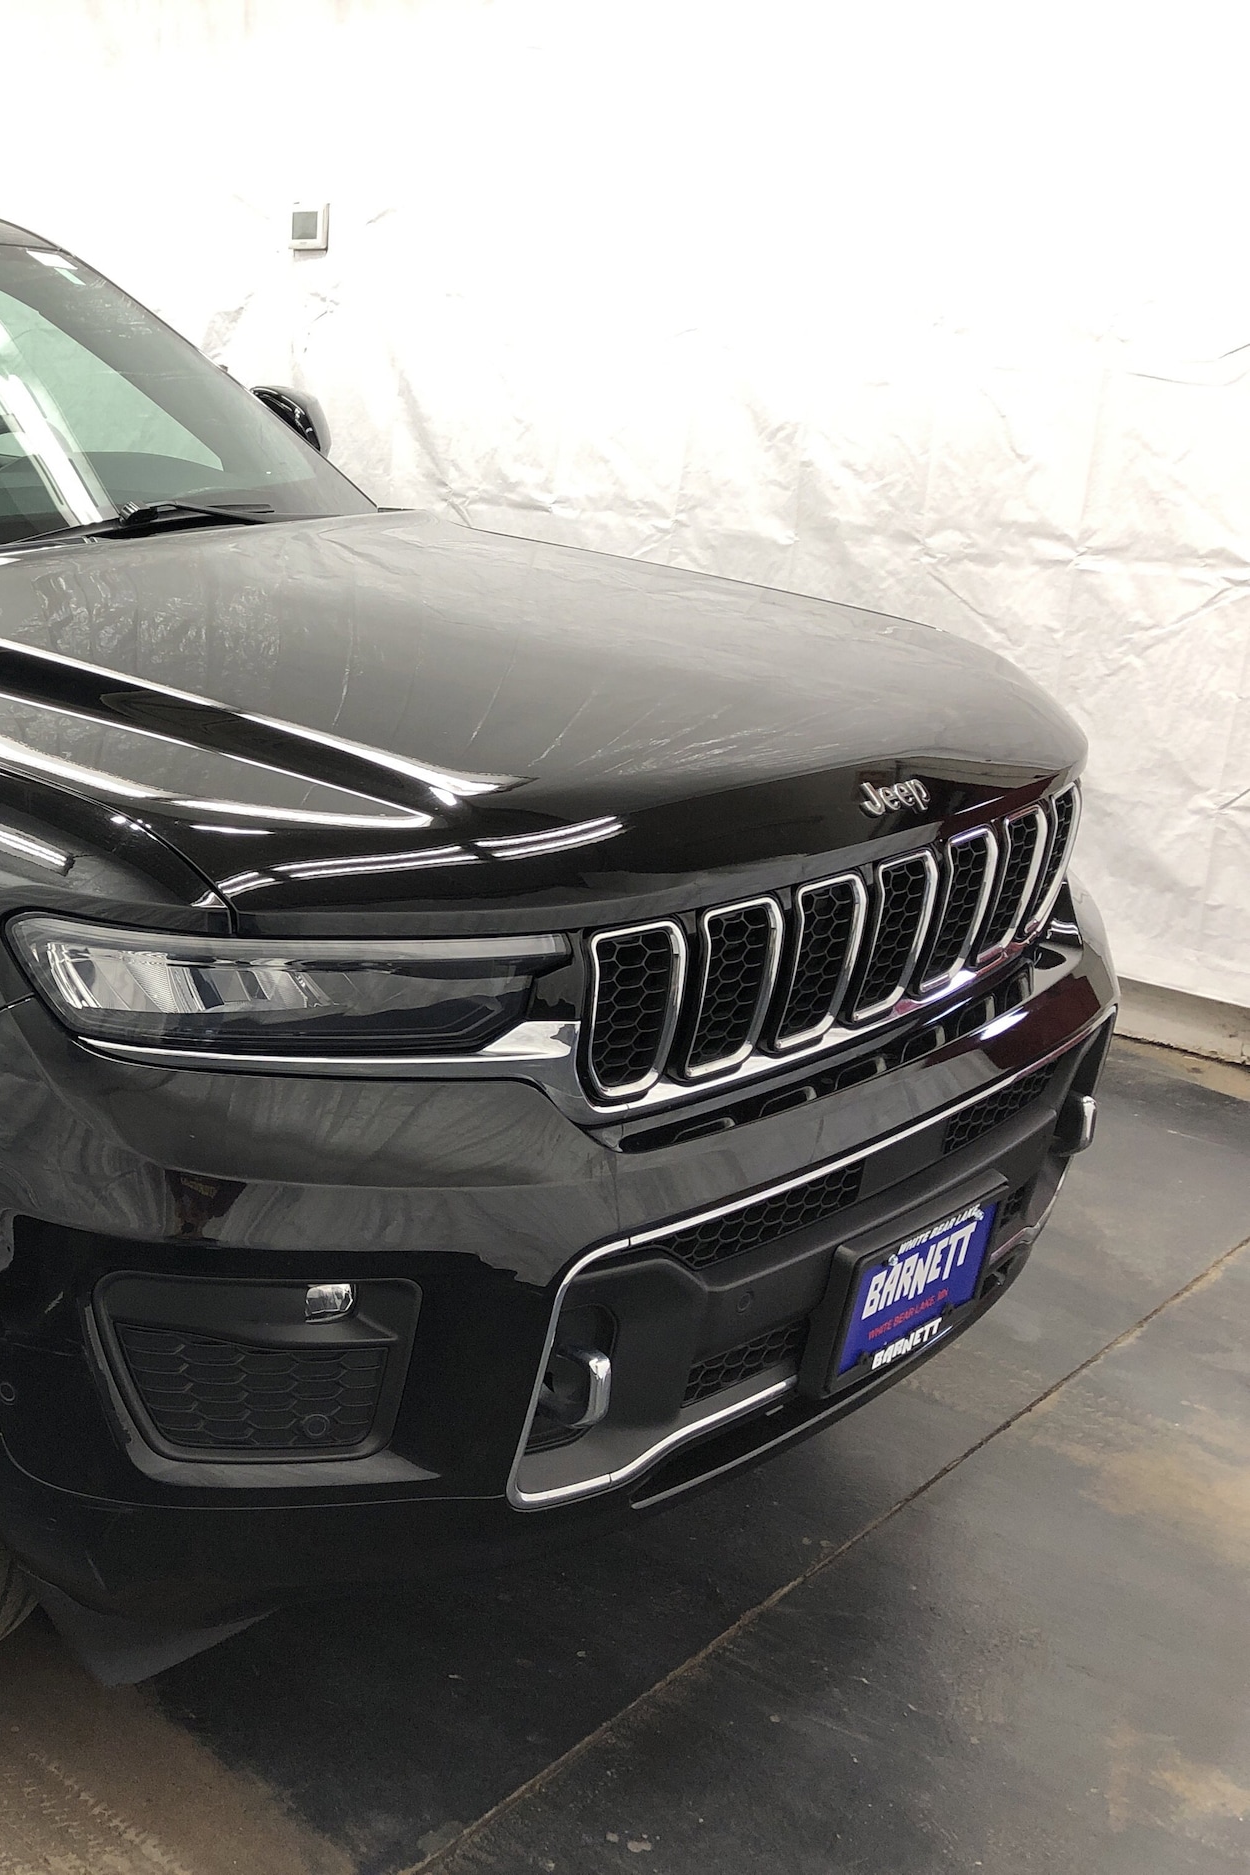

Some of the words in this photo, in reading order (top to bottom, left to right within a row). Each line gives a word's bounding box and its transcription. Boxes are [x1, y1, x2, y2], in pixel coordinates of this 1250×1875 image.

[859, 779, 931, 816] Jeep
[898, 1230, 931, 1255] WHITE
[929, 1217, 957, 1240] BEAR
[861, 1221, 978, 1321] BARNETT
[871, 1316, 943, 1370] BARNETT
